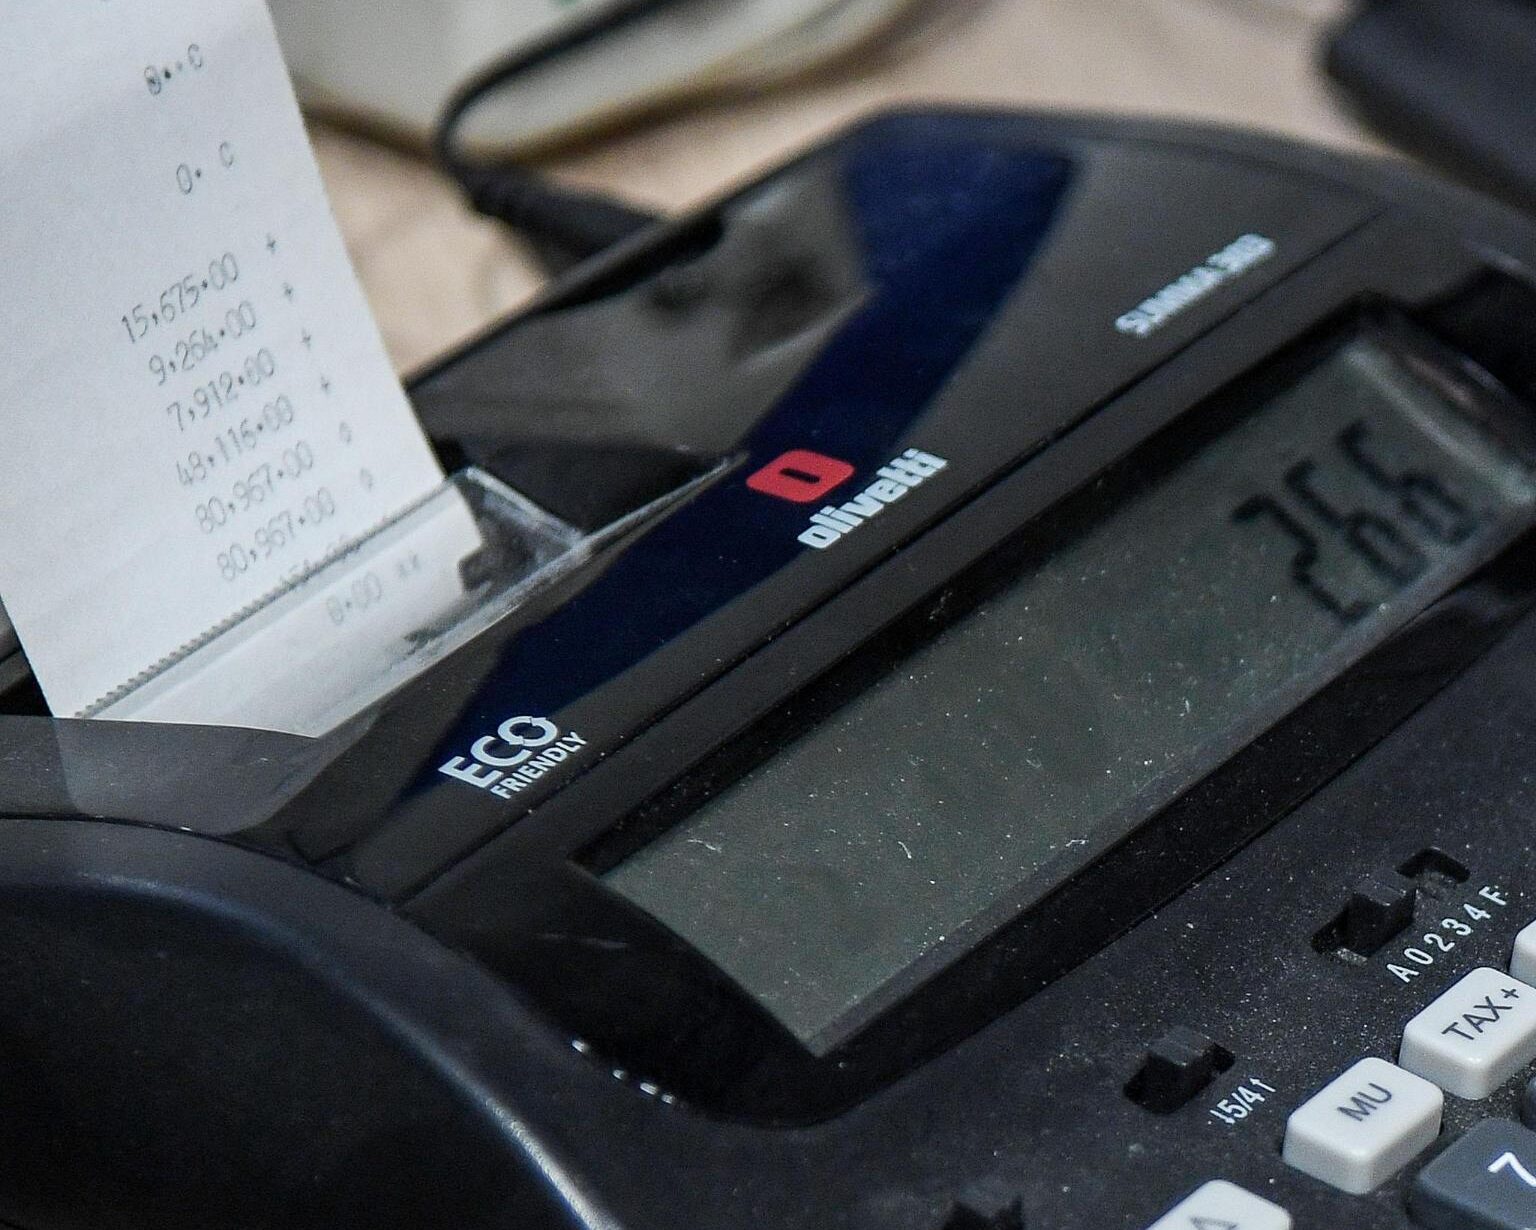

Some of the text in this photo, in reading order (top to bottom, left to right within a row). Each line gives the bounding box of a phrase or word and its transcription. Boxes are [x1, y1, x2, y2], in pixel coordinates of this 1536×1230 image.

[796, 447, 949, 549] olivetti
[437, 715, 559, 789] ECO
[489, 730, 589, 800] FRIENDLY
[1441, 987, 1521, 1041] TAX+
[1336, 1081, 1393, 1123] MU
